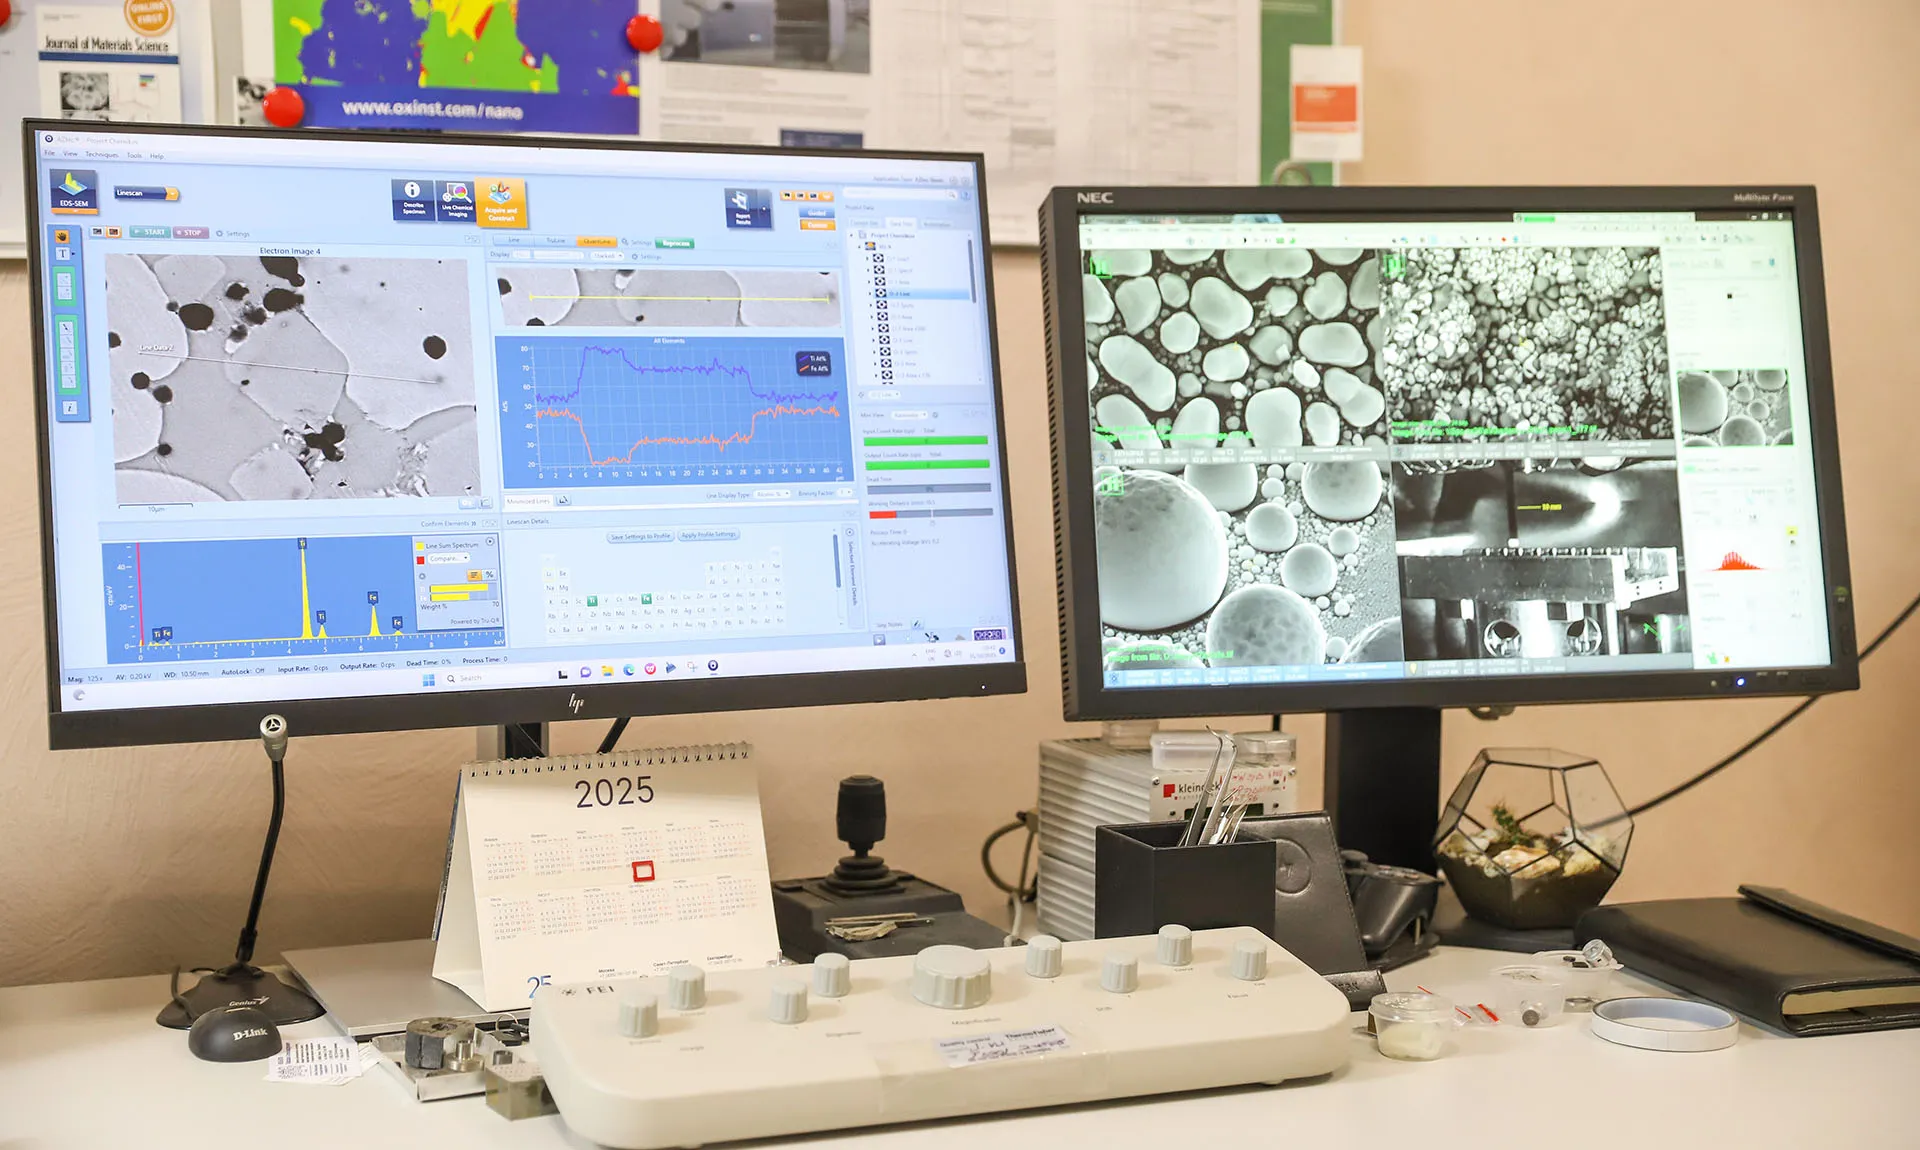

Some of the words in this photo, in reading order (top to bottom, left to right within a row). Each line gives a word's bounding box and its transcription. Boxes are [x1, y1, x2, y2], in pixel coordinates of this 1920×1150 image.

[45, 36, 78, 50] Journal
[81, 36, 89, 49] of
[92, 37, 132, 51] Materials
[135, 38, 168, 52] Science
[342, 98, 524, 120] www.oxinst.com/nano
[86, 151, 119, 159] Techniques
[1077, 192, 1114, 203] NEC
[260, 247, 289, 255] Electron
[292, 248, 314, 257] Image
[718, 492, 736, 500] Display
[452, 542, 479, 550] Spectrum
[278, 666, 293, 674] Input
[569, 693, 584, 713] hp
[575, 776, 654, 808] 2025
[587, 985, 614, 995] FEI
[233, 1027, 268, 1041] D-Link
